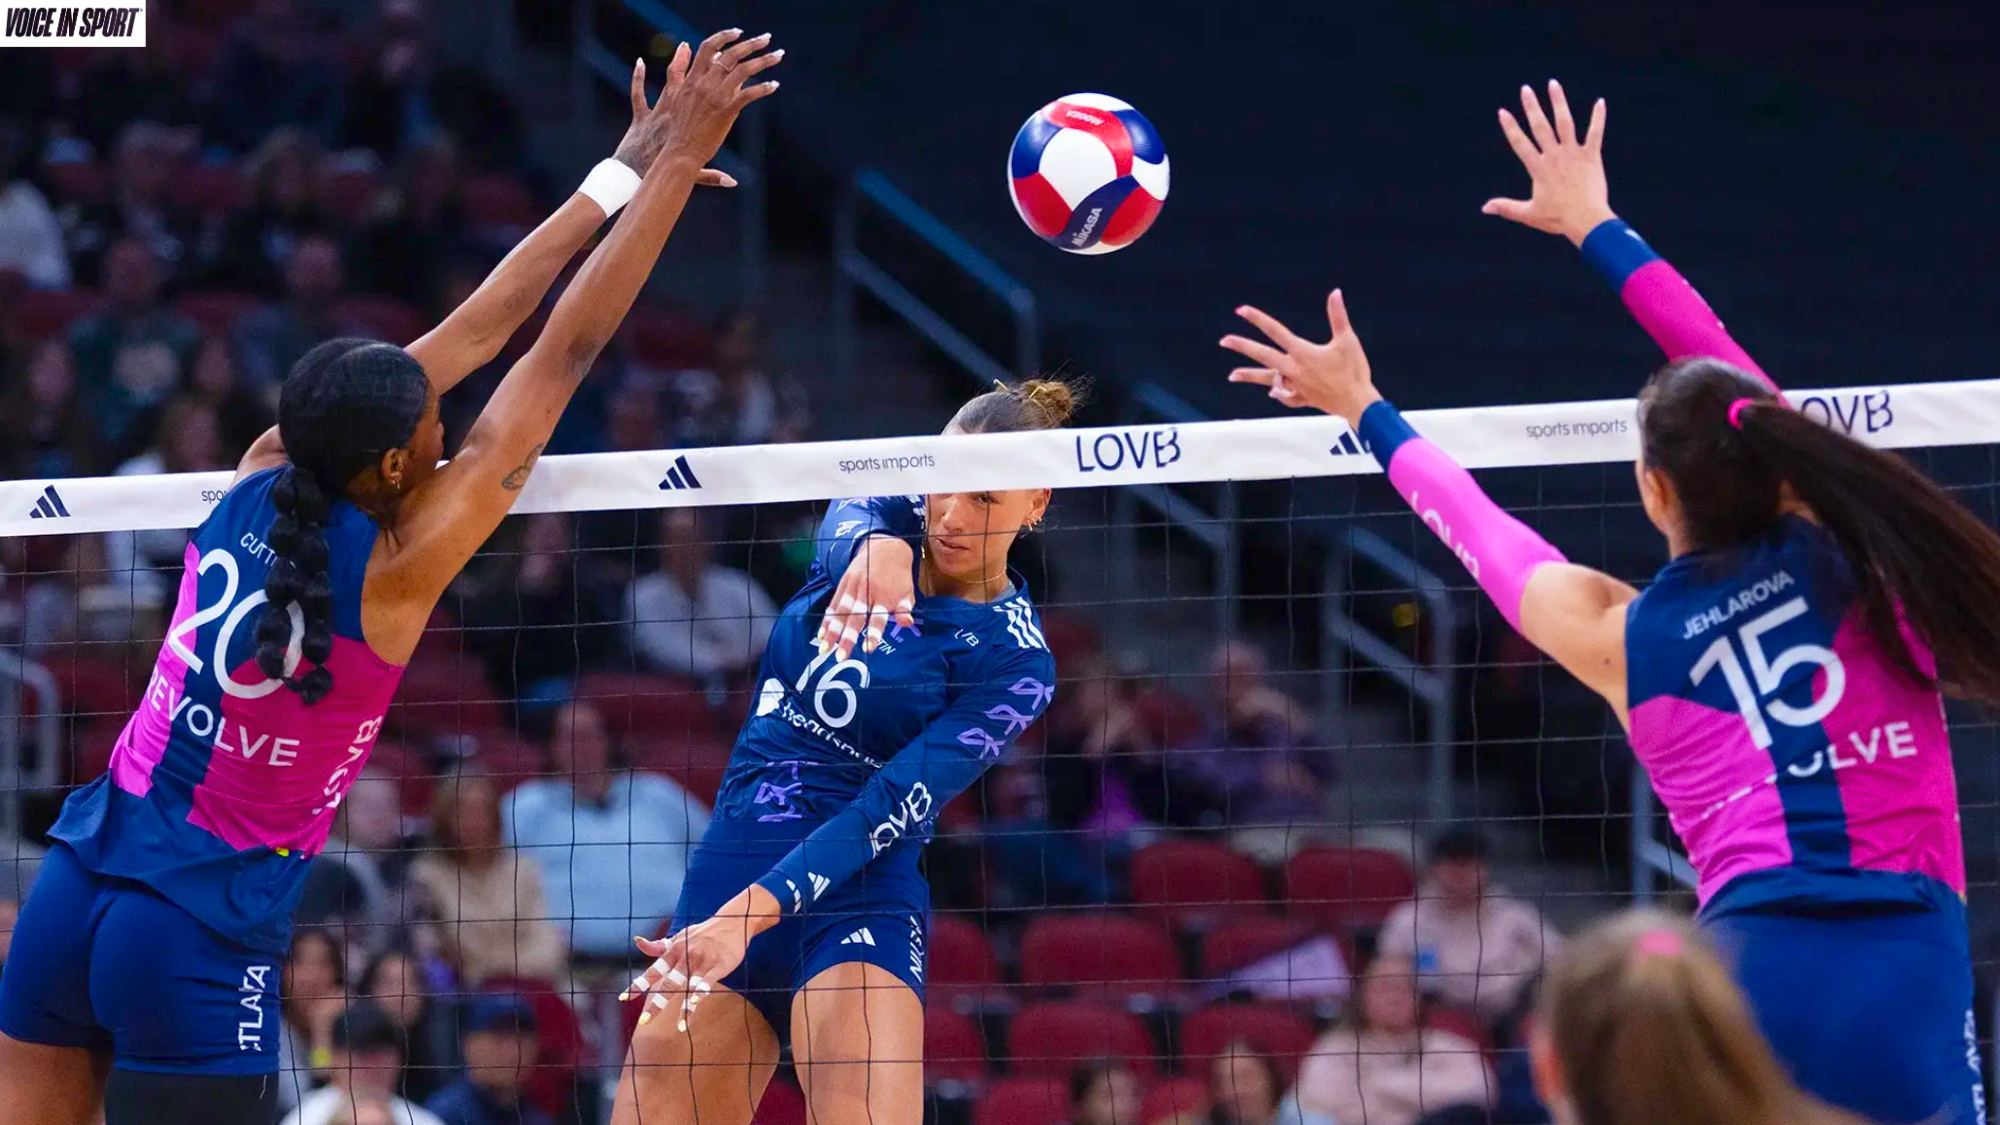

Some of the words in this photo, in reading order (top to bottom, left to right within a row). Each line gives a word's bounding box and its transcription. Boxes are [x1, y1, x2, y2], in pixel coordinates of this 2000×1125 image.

[1065, 109, 1105, 126] V200W
[1525, 422, 1571, 440] sports
[1572, 418, 1629, 437] imports
[1800, 389, 1894, 435] OVB
[838, 457, 880, 475] sports
[881, 453, 936, 472] imports
[1075, 426, 1182, 473] LOVB
[200, 489, 228, 504] spo
[168, 547, 305, 699] 20
[1682, 570, 1795, 640] JEHLAROVA
[1688, 595, 1846, 751] 15
